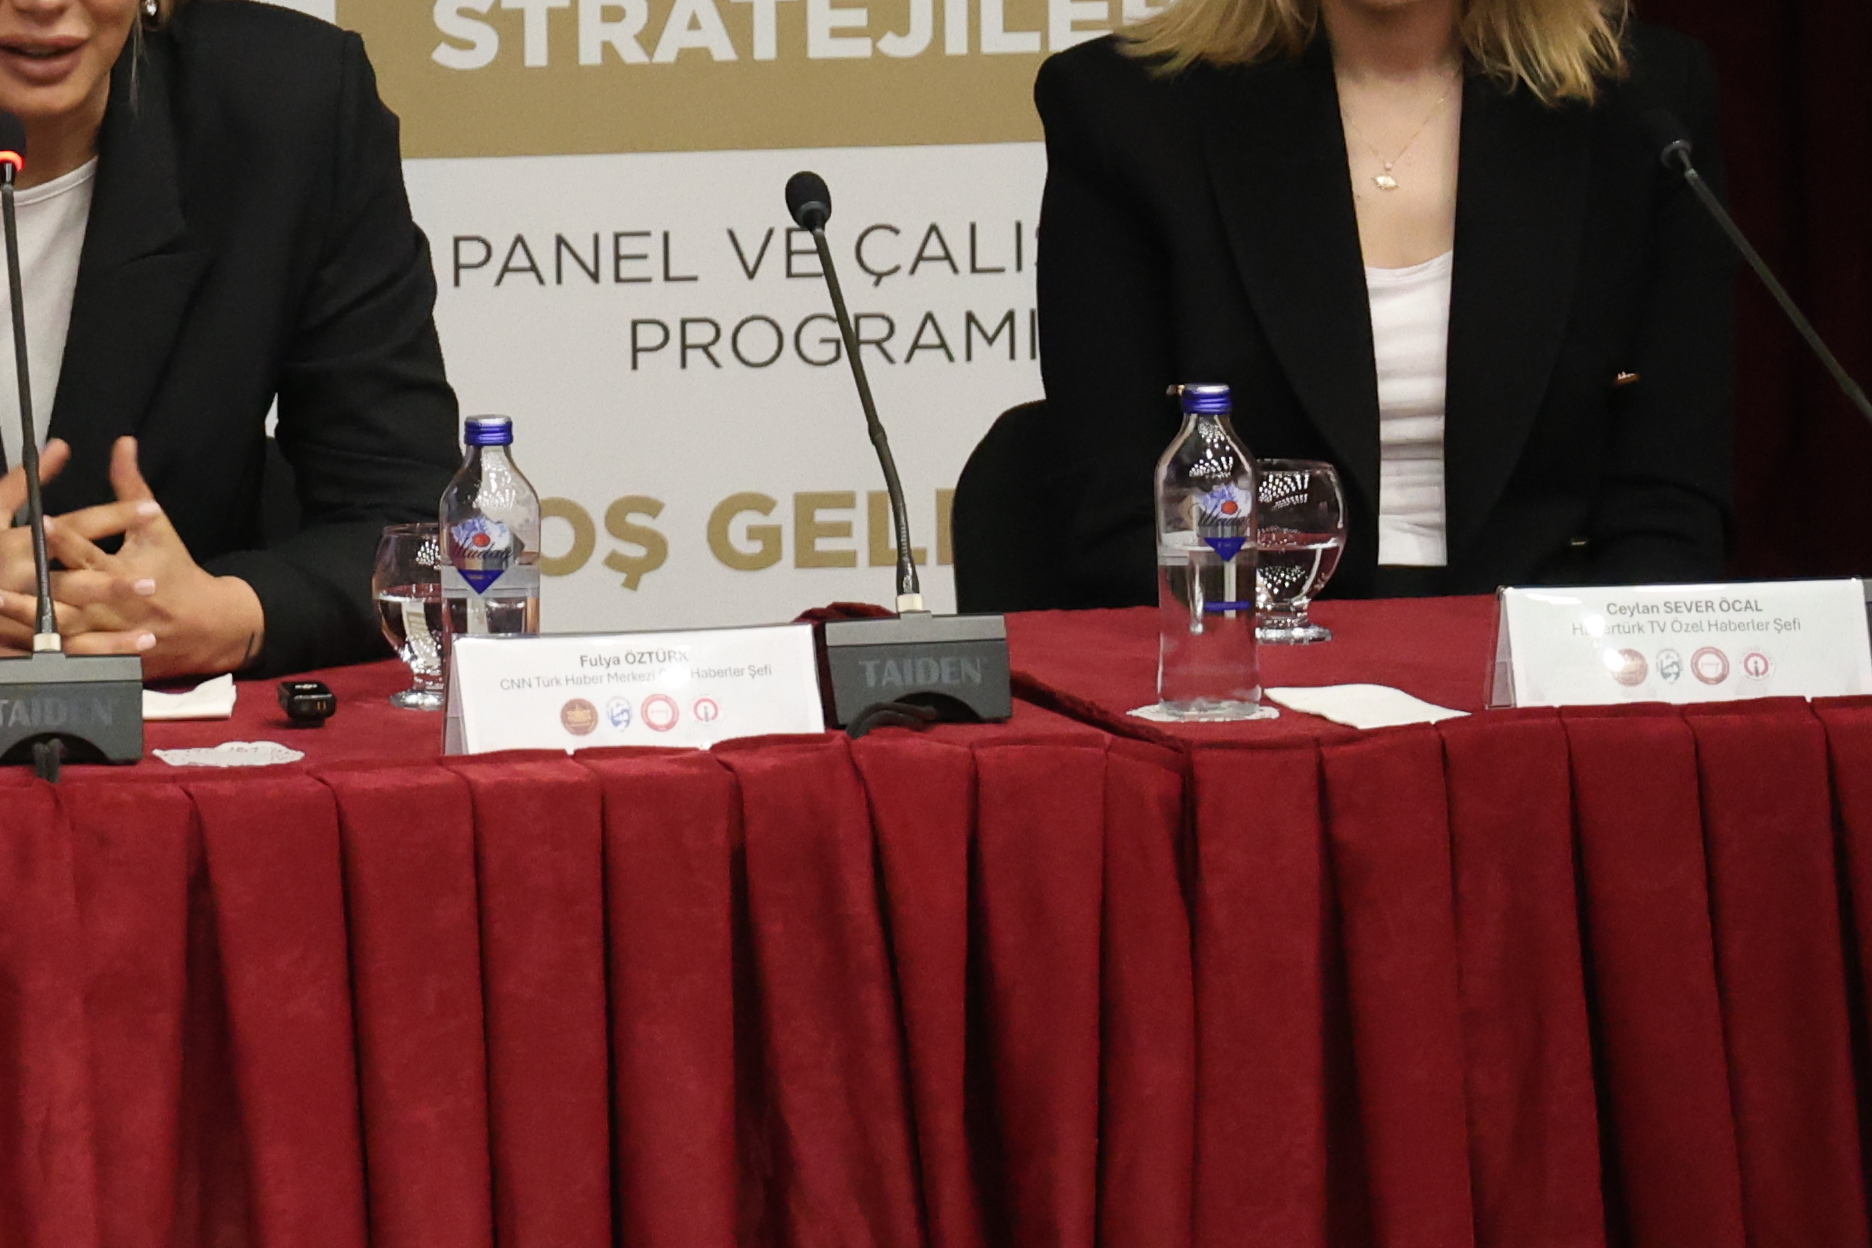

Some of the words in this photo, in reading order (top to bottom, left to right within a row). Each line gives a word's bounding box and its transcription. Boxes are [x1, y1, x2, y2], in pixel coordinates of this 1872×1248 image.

[453, 230, 699, 288] PANEL
[728, 227, 825, 281] VE
[855, 222, 1039, 288] ÇALI
[631, 309, 1036, 371] PROGRAMI
[540, 495, 669, 591] OŞ
[1606, 602, 1660, 618] Ceylan
[1664, 600, 1716, 614] SEVER
[1719, 597, 1763, 613] ÖCAL
[1572, 621, 1645, 636] Hertürk
[1648, 620, 1666, 634] TV
[1671, 617, 1704, 633] Özel
[1708, 617, 1770, 633] Haberler
[1773, 617, 1801, 635] Şefi
[580, 653, 621, 669] Fulya
[859, 657, 982, 689] TAIDEN
[500, 677, 532, 691] CNN
[534, 674, 562, 689] Türk
[565, 671, 603, 686] Haber
[607, 668, 656, 684] Merkezi
[690, 664, 745, 680] Haberler
[748, 662, 773, 680] Şefi
